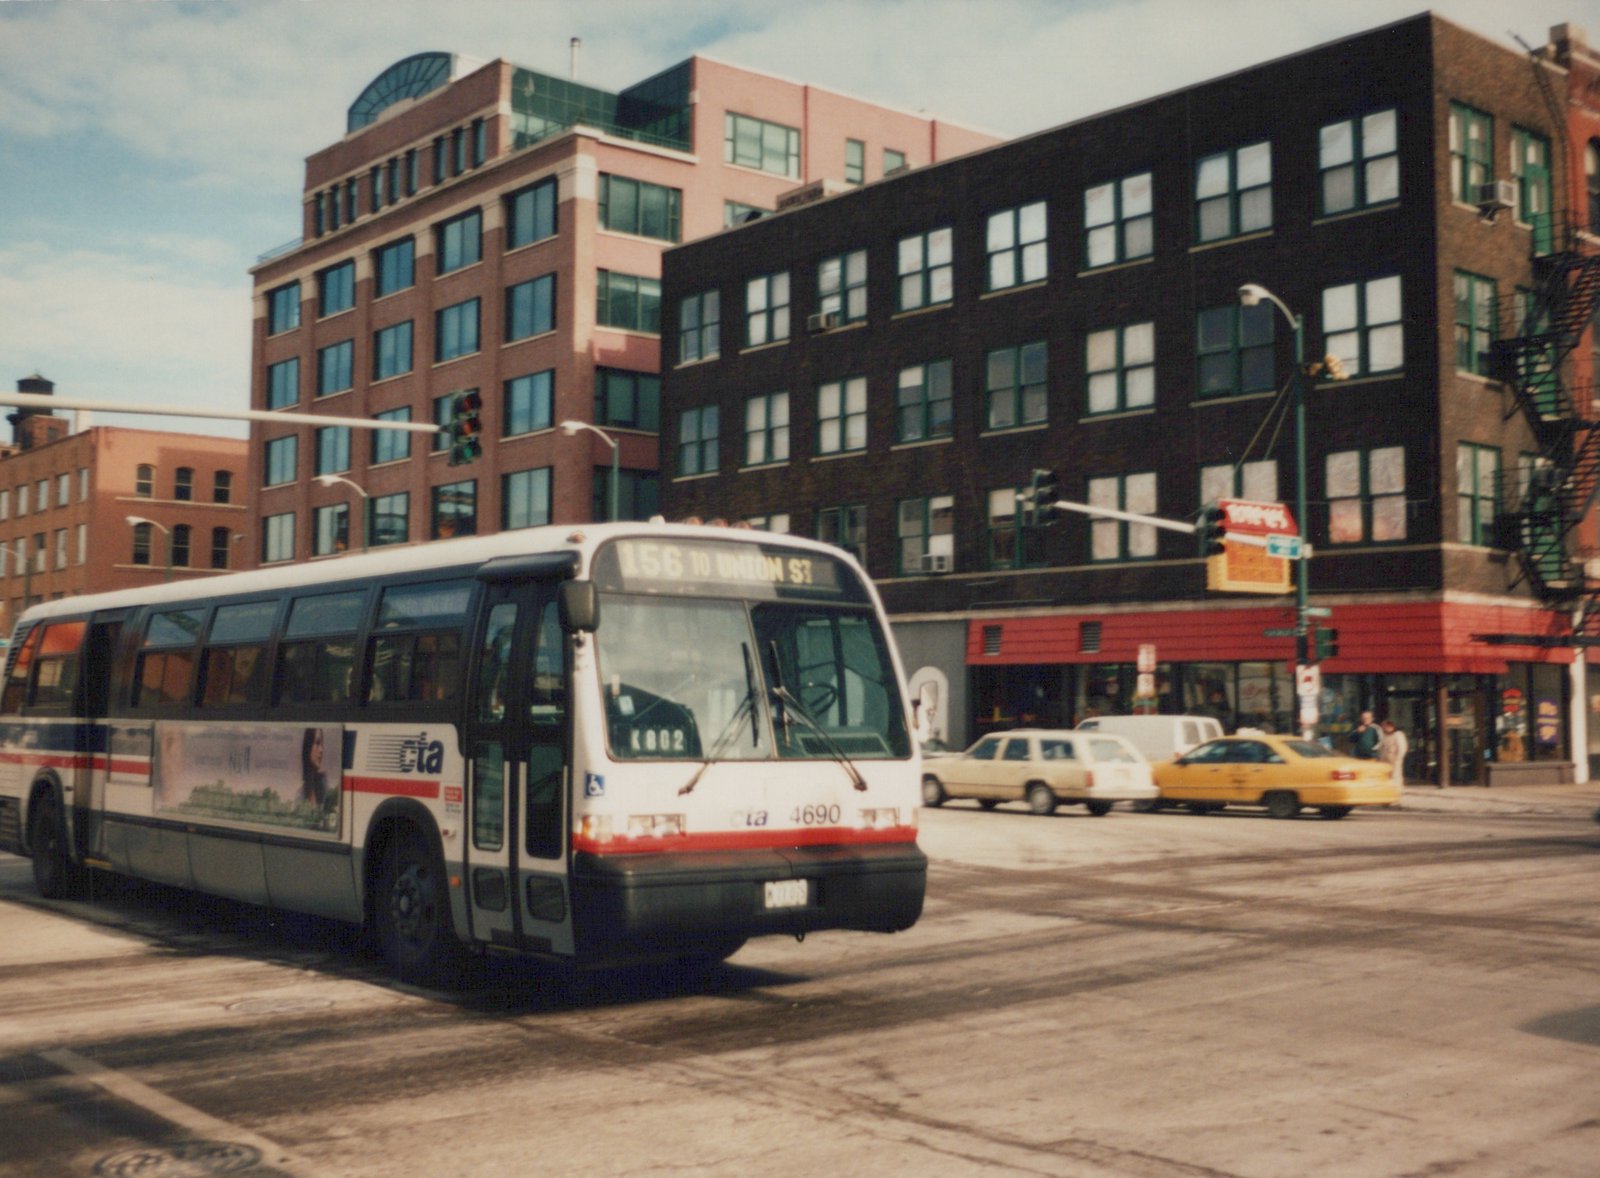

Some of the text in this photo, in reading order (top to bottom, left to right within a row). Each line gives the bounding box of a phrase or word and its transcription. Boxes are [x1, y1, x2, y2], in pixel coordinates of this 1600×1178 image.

[621, 542, 683, 578] 156
[689, 550, 710, 577] TO
[717, 552, 784, 583] UNION
[400, 731, 444, 774] cta
[790, 804, 841, 825] 4690
